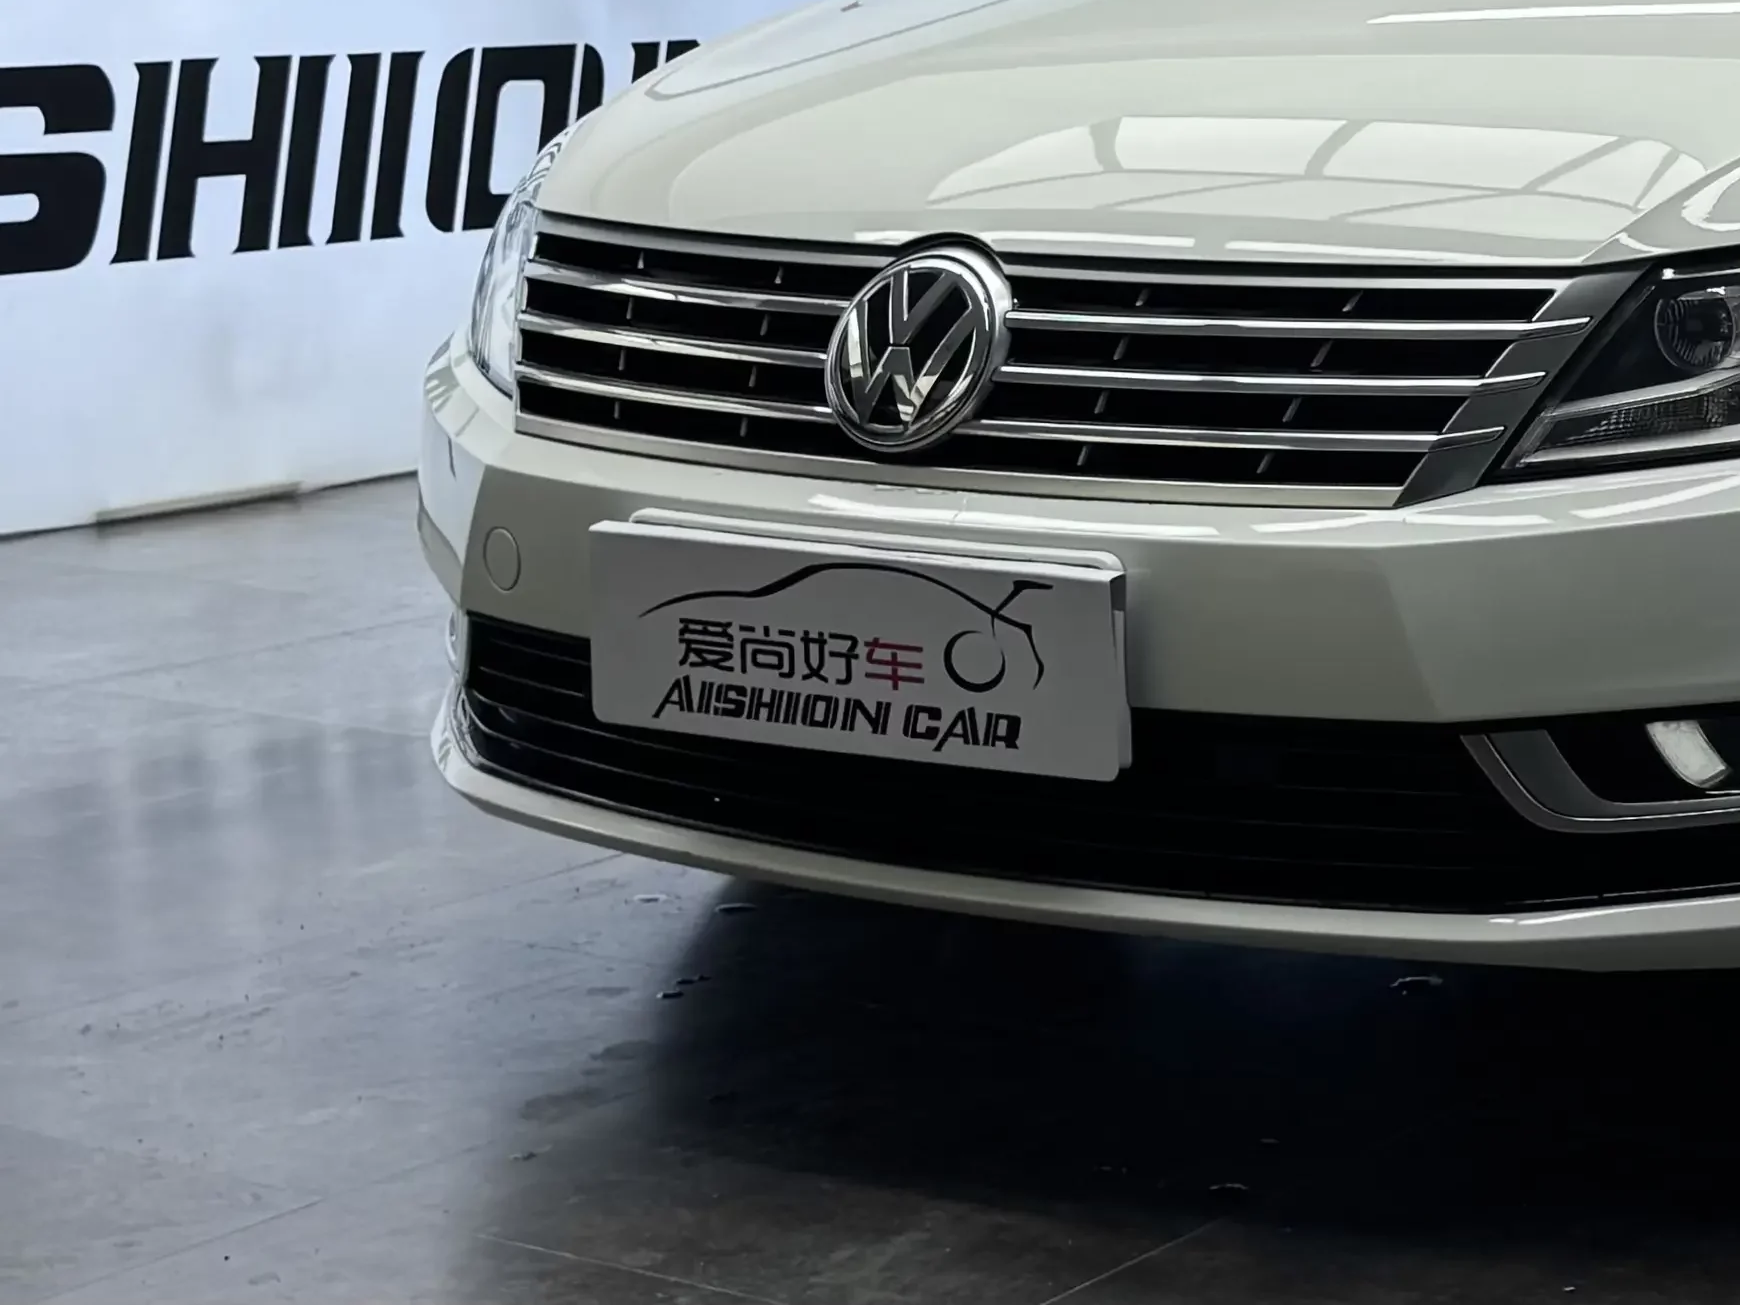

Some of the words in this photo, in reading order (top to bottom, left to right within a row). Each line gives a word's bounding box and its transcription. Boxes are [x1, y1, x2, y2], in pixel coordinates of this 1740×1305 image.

[677, 616, 926, 691] 爱尚好车
[652, 674, 892, 736] AISHION
[902, 703, 1023, 752] CAR
